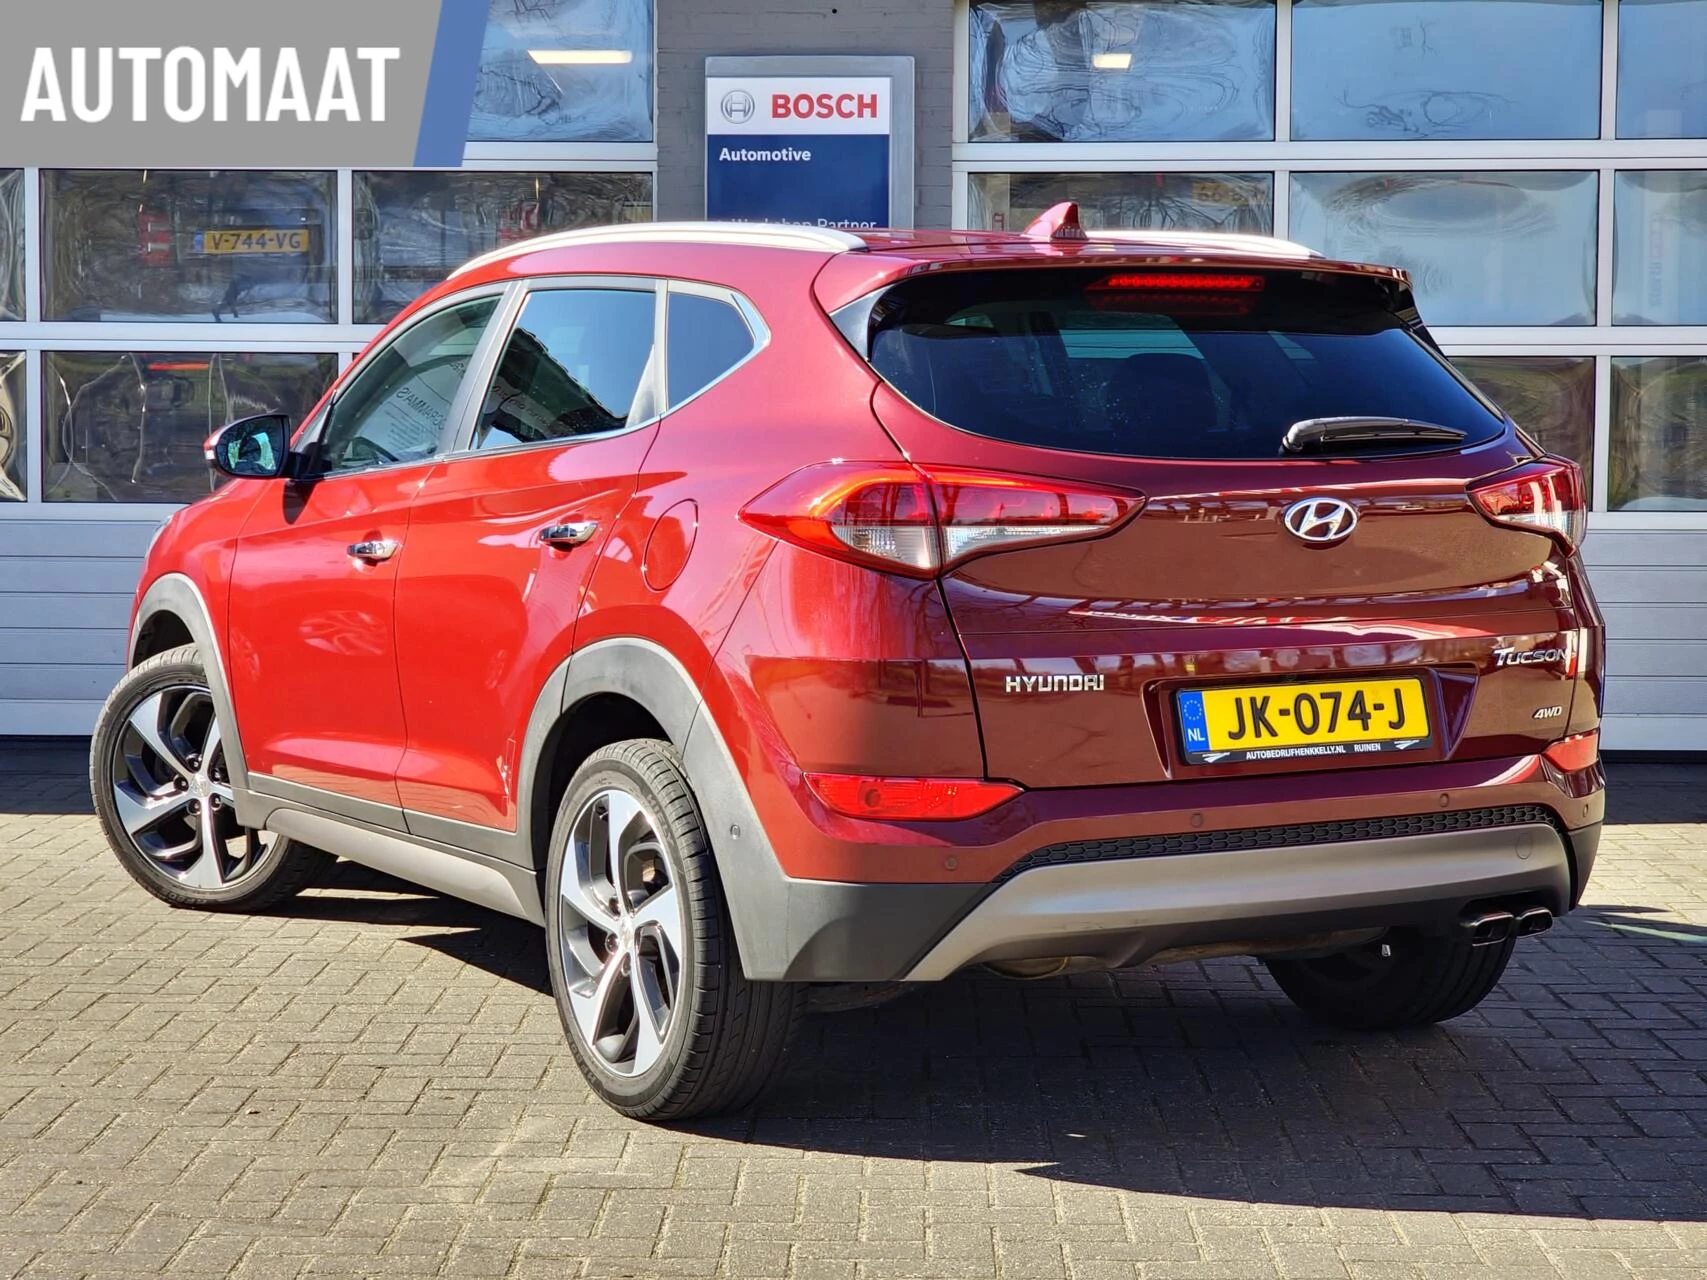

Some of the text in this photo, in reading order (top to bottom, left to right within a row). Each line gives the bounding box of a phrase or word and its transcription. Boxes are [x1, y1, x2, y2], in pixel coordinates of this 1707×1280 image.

[771, 93, 878, 119] BOSCH
[718, 147, 812, 161] Automotive
[212, 232, 301, 250] V-744-VG
[1005, 674, 1105, 692] HYUNDAI
[1227, 687, 1405, 741] JK-074-J
[1533, 705, 1563, 719] 4WD
[1187, 729, 1206, 742] NL
[1354, 743, 1381, 753] RUINEN
